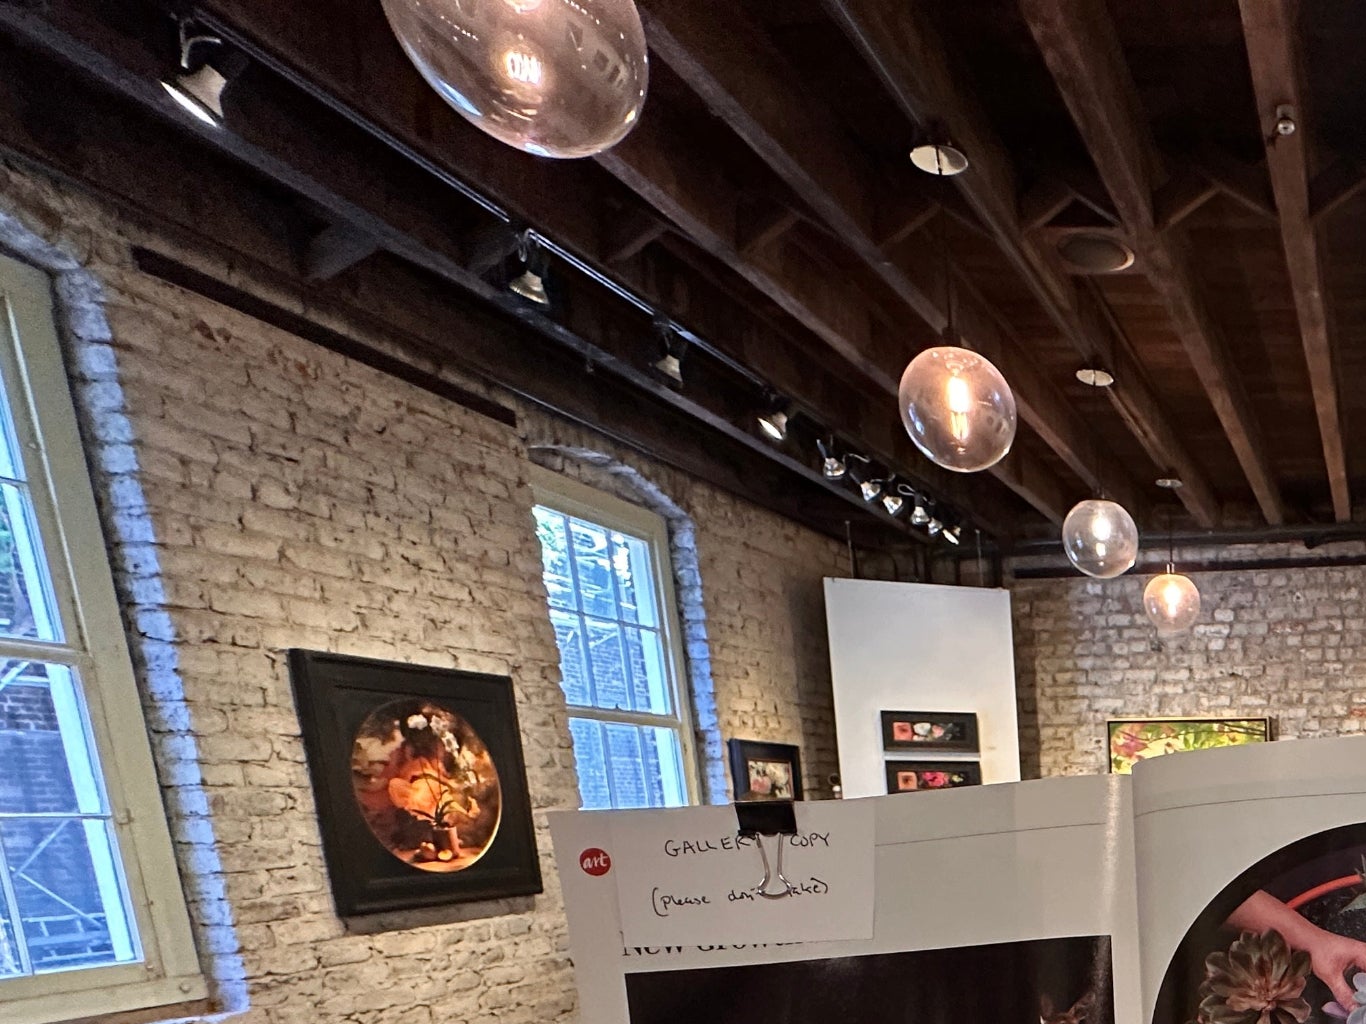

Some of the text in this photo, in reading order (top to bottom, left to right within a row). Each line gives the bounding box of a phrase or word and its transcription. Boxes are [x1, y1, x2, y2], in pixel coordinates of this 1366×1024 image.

[790, 832, 829, 847] COPY
[582, 852, 609, 870] art
[652, 888, 710, 917] (please
